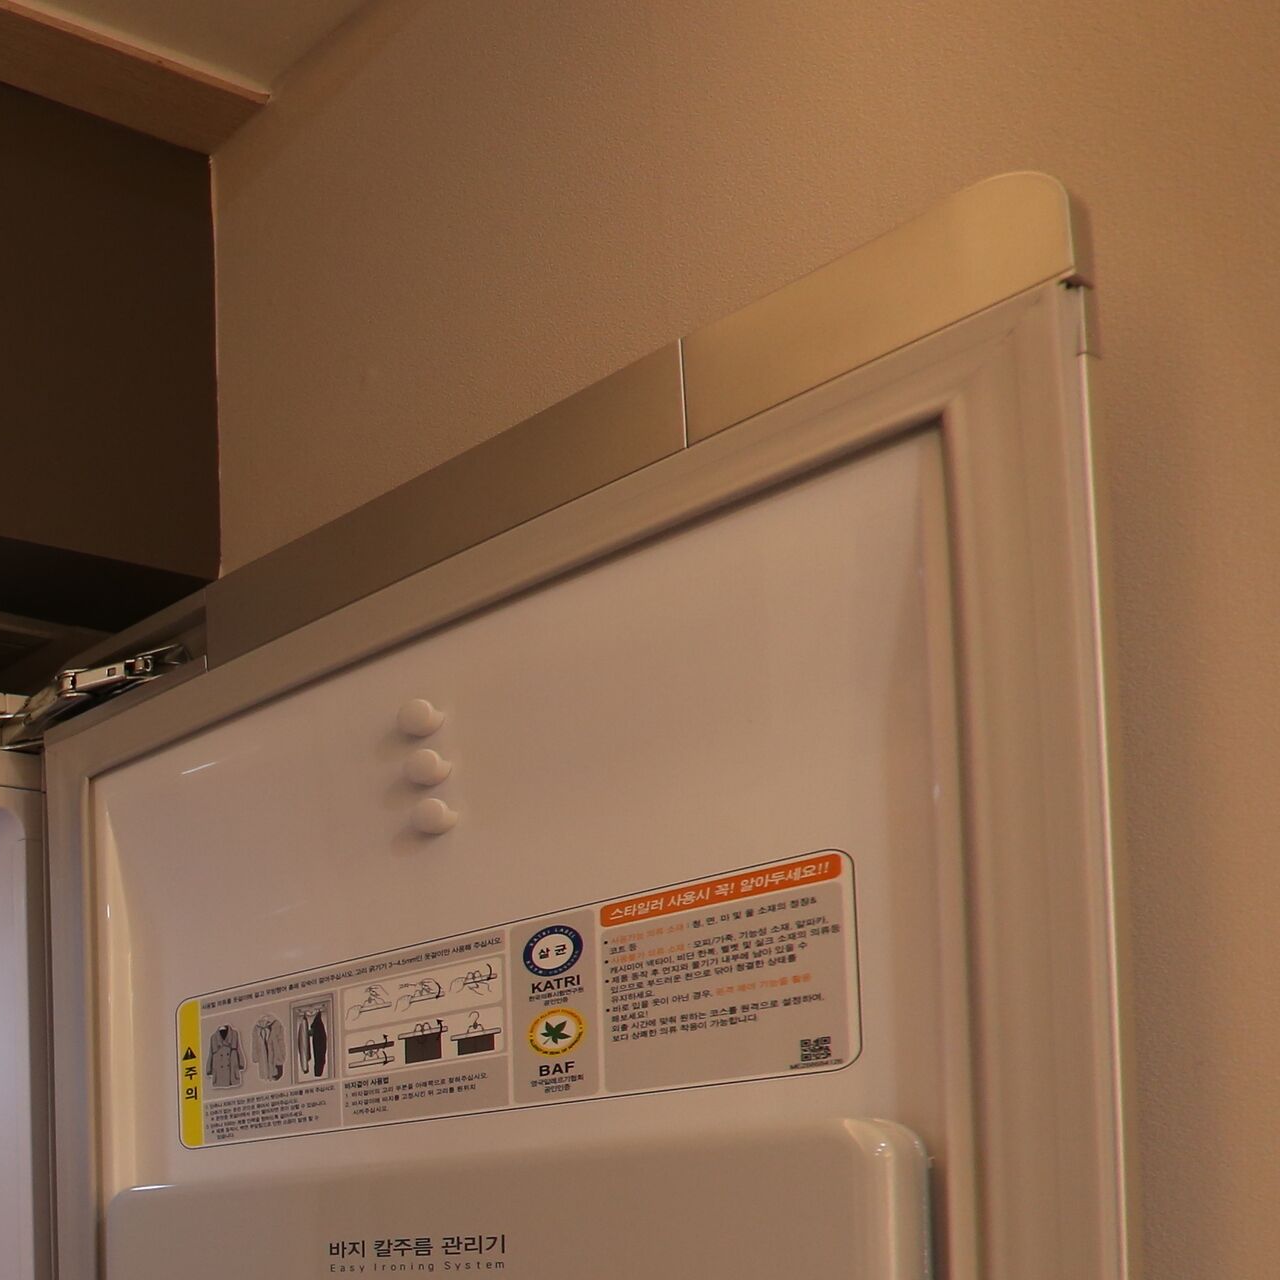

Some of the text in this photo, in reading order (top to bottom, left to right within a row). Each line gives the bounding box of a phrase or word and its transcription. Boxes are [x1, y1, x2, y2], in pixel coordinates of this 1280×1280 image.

[609, 859, 830, 921] 스타일러 사용시 꼭! 알아두세요!!
[757, 901, 785, 915] 소재의
[677, 951, 694, 962] 비단
[778, 929, 806, 944] 소재의
[810, 923, 840, 938] 의류등
[738, 926, 766, 940] 기능성
[609, 943, 637, 955] 코트 등
[611, 973, 628, 984] 제품
[651, 967, 659, 977] 후
[721, 950, 749, 964] 내부에
[753, 946, 771, 958] 남아
[775, 942, 793, 954] 있을
[797, 940, 807, 950] 수
[531, 973, 581, 994] KATRI
[610, 980, 643, 994] 있으므로
[646, 974, 681, 988] 부드러운
[612, 1003, 629, 1014] 바로
[632, 999, 648, 1011] 입을
[652, 996, 668, 1007] 옷이
[672, 993, 689, 1004] 아닌
[631, 1018, 656, 1030] 시간에
[680, 1010, 706, 1023] 원하는
[710, 1005, 737, 1018] 코스를
[611, 1032, 628, 1043] 보다
[660, 1025, 676, 1036] 의류
[539, 1060, 575, 1077] BAF
[329, 1234, 506, 1258] 바지 칼주름 관리기
[330, 1261, 505, 1273] Easy Ironing System
